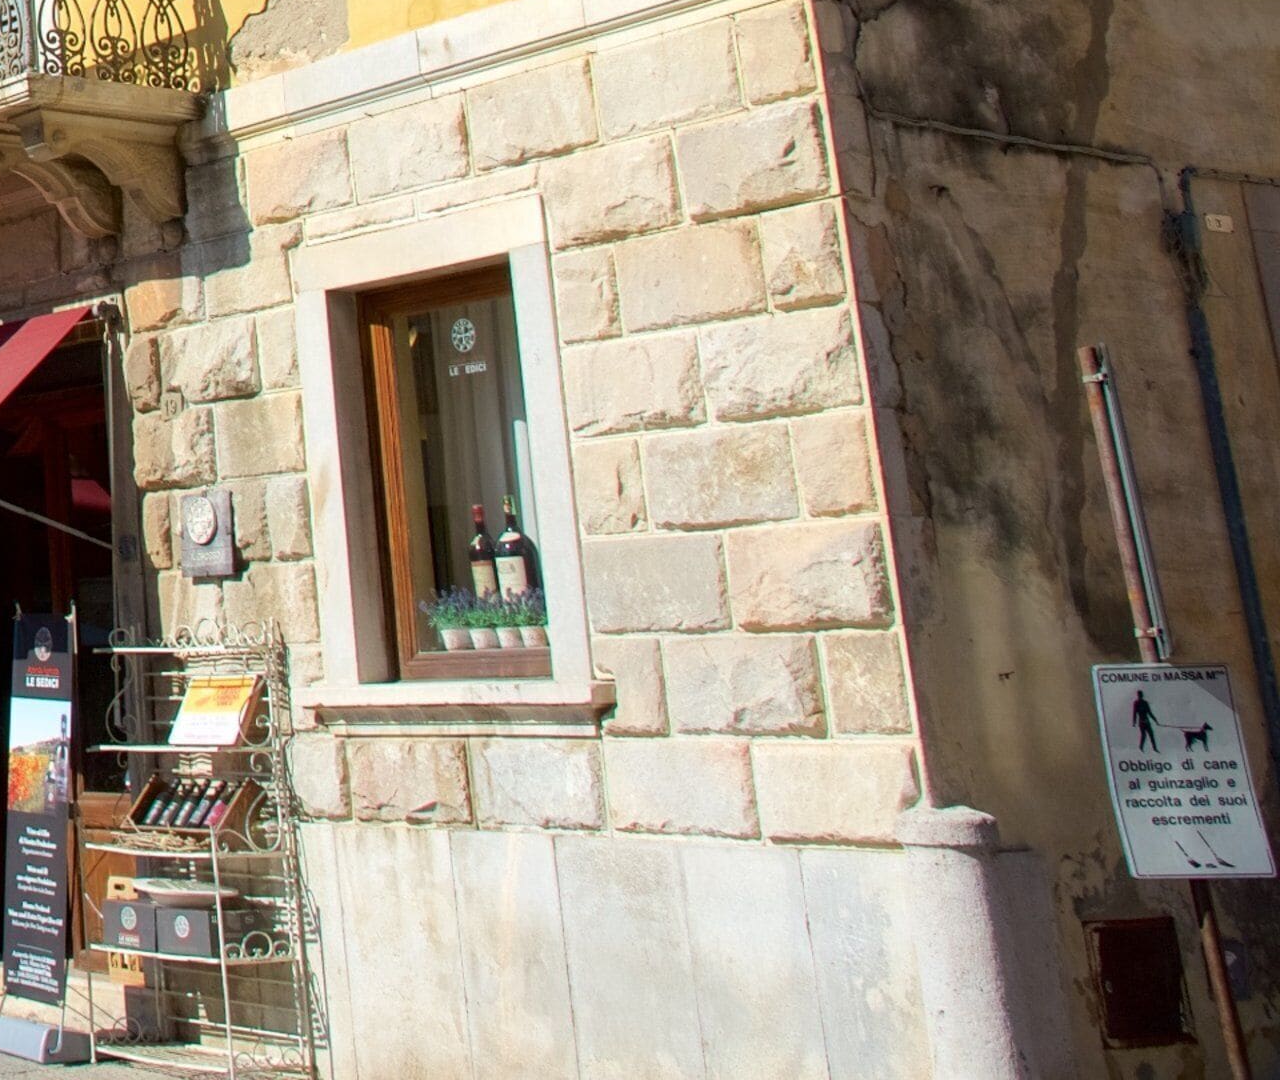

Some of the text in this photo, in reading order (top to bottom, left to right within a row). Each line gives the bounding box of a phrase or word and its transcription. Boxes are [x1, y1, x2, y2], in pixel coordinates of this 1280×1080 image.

[449, 365, 459, 376] LE
[25, 676, 60, 689] LE SEDICI
[1101, 672, 1149, 683] COMUNE
[1164, 670, 1204, 681] MASSA
[1118, 759, 1238, 774] Obbligo di cane
[1128, 776, 1236, 793] al guinzaglio e
[1125, 793, 1248, 808] raccolta dei suoi
[1151, 813, 1231, 826] escrementi
